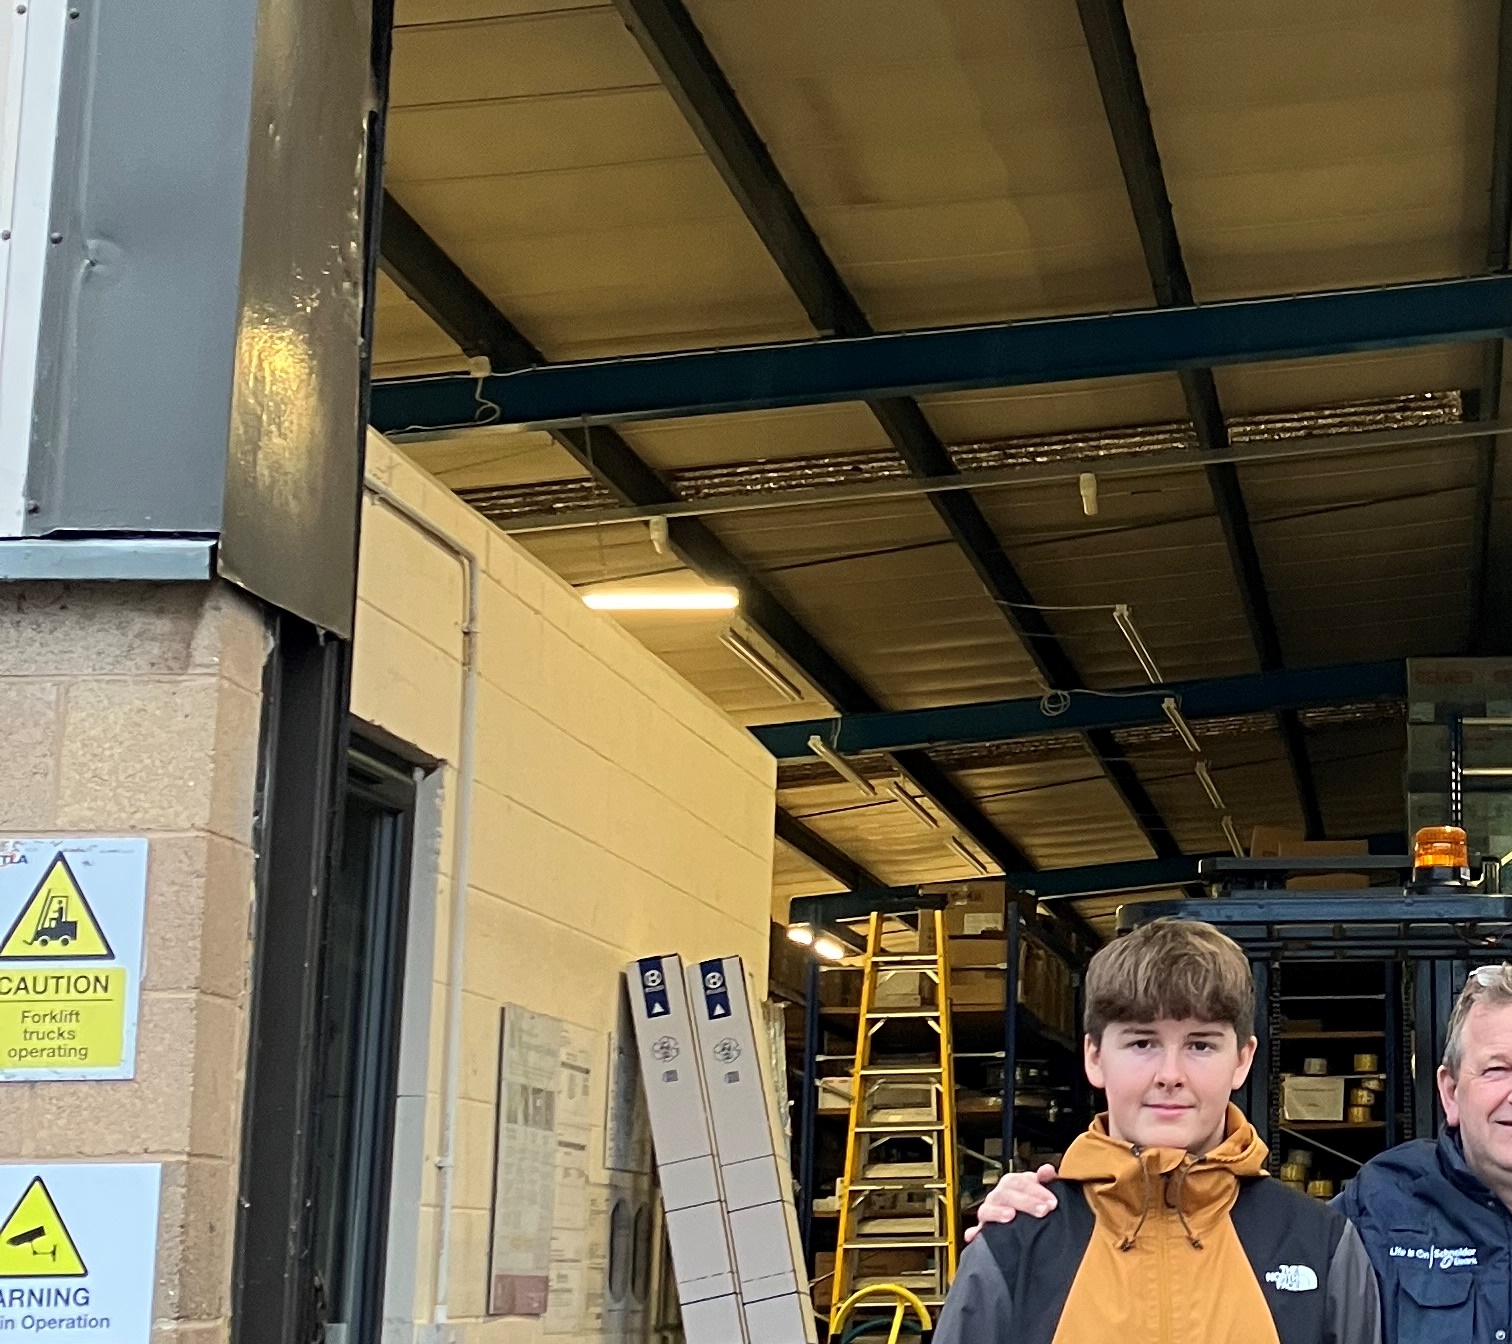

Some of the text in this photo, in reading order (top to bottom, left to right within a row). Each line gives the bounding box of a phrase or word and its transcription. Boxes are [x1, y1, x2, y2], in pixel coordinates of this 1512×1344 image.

[0, 975, 110, 995] CAUTION
[20, 1009, 81, 1024] Forklift
[22, 1027, 77, 1041] trucks
[7, 1045, 89, 1062] operating
[21, 1314, 110, 1333] Operation
